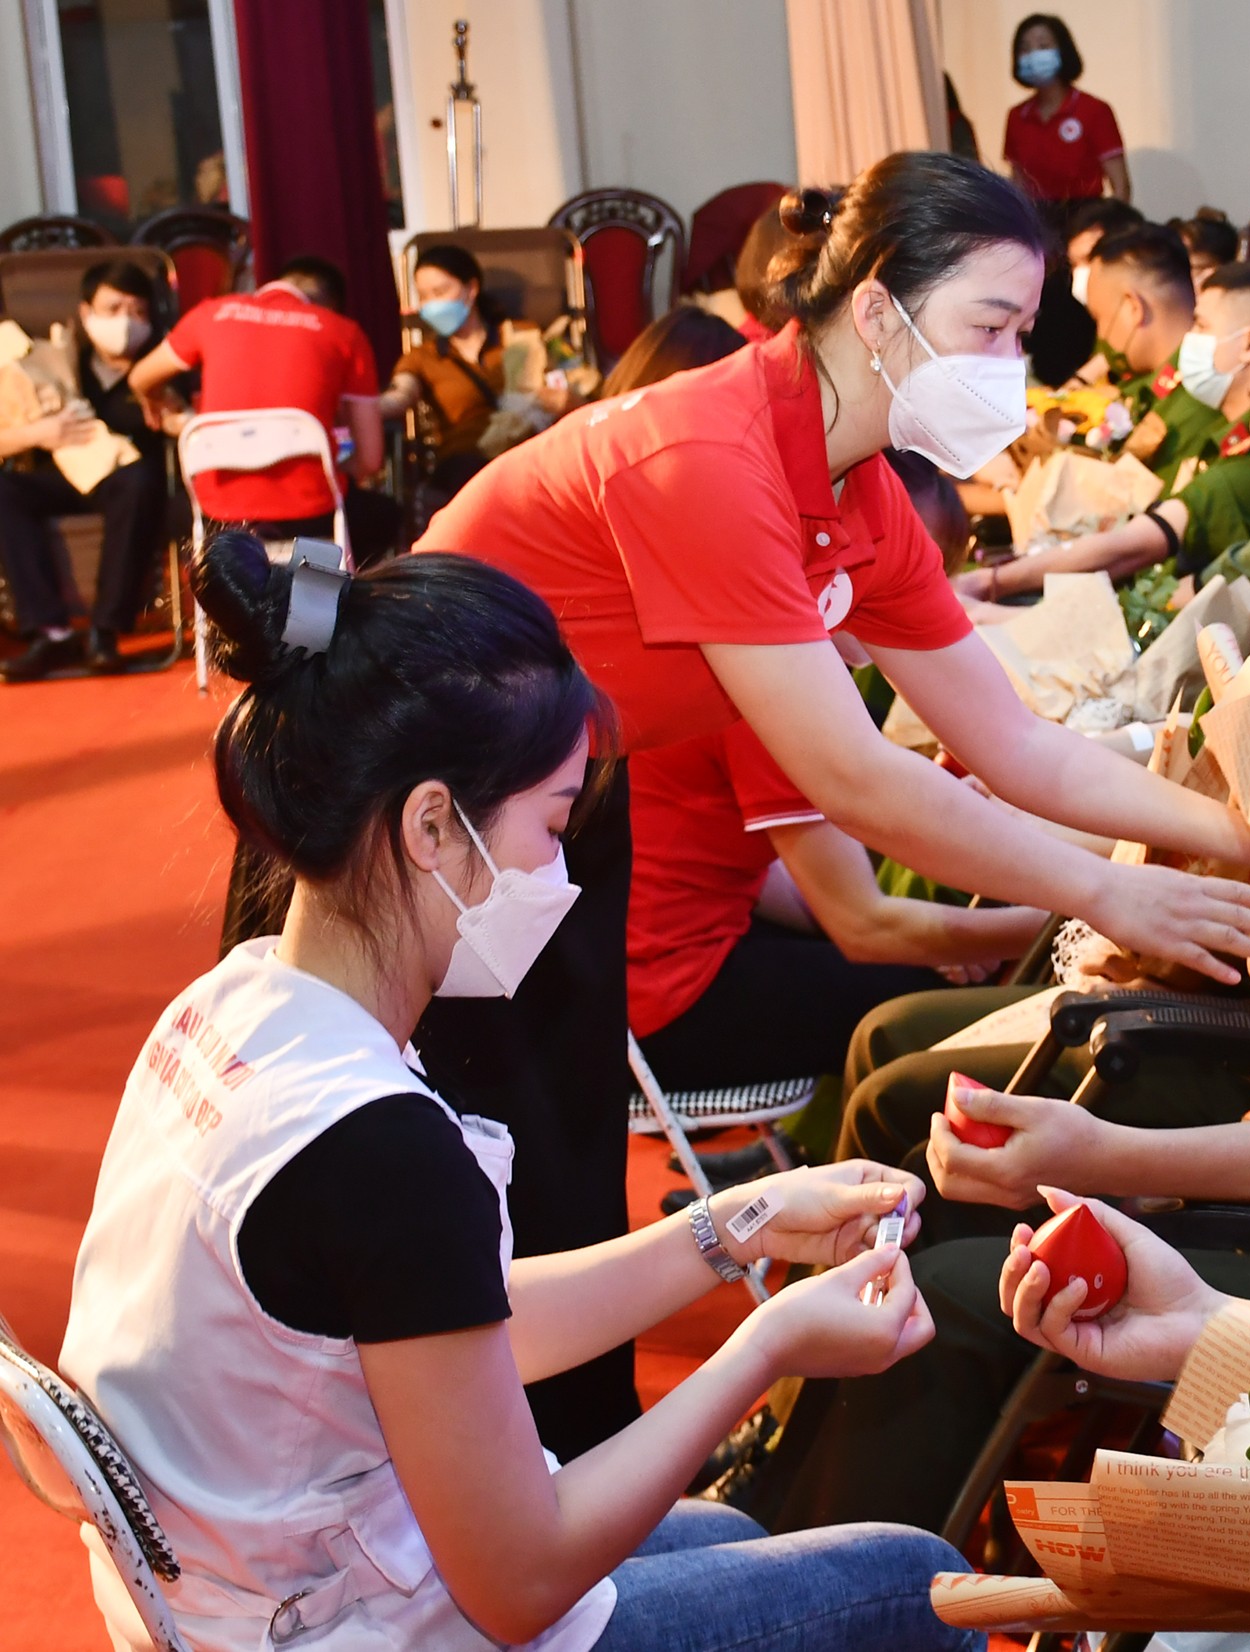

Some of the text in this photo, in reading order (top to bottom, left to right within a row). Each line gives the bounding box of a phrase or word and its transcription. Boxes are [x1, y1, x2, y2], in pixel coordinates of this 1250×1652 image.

[1117, 1460, 1160, 1479] think
[1166, 1464, 1197, 1483] you
[1204, 1465, 1232, 1480] are
[1161, 1489, 1178, 1497] has
[1222, 1492, 1237, 1500] the
[1050, 1506, 1077, 1517] FOR
